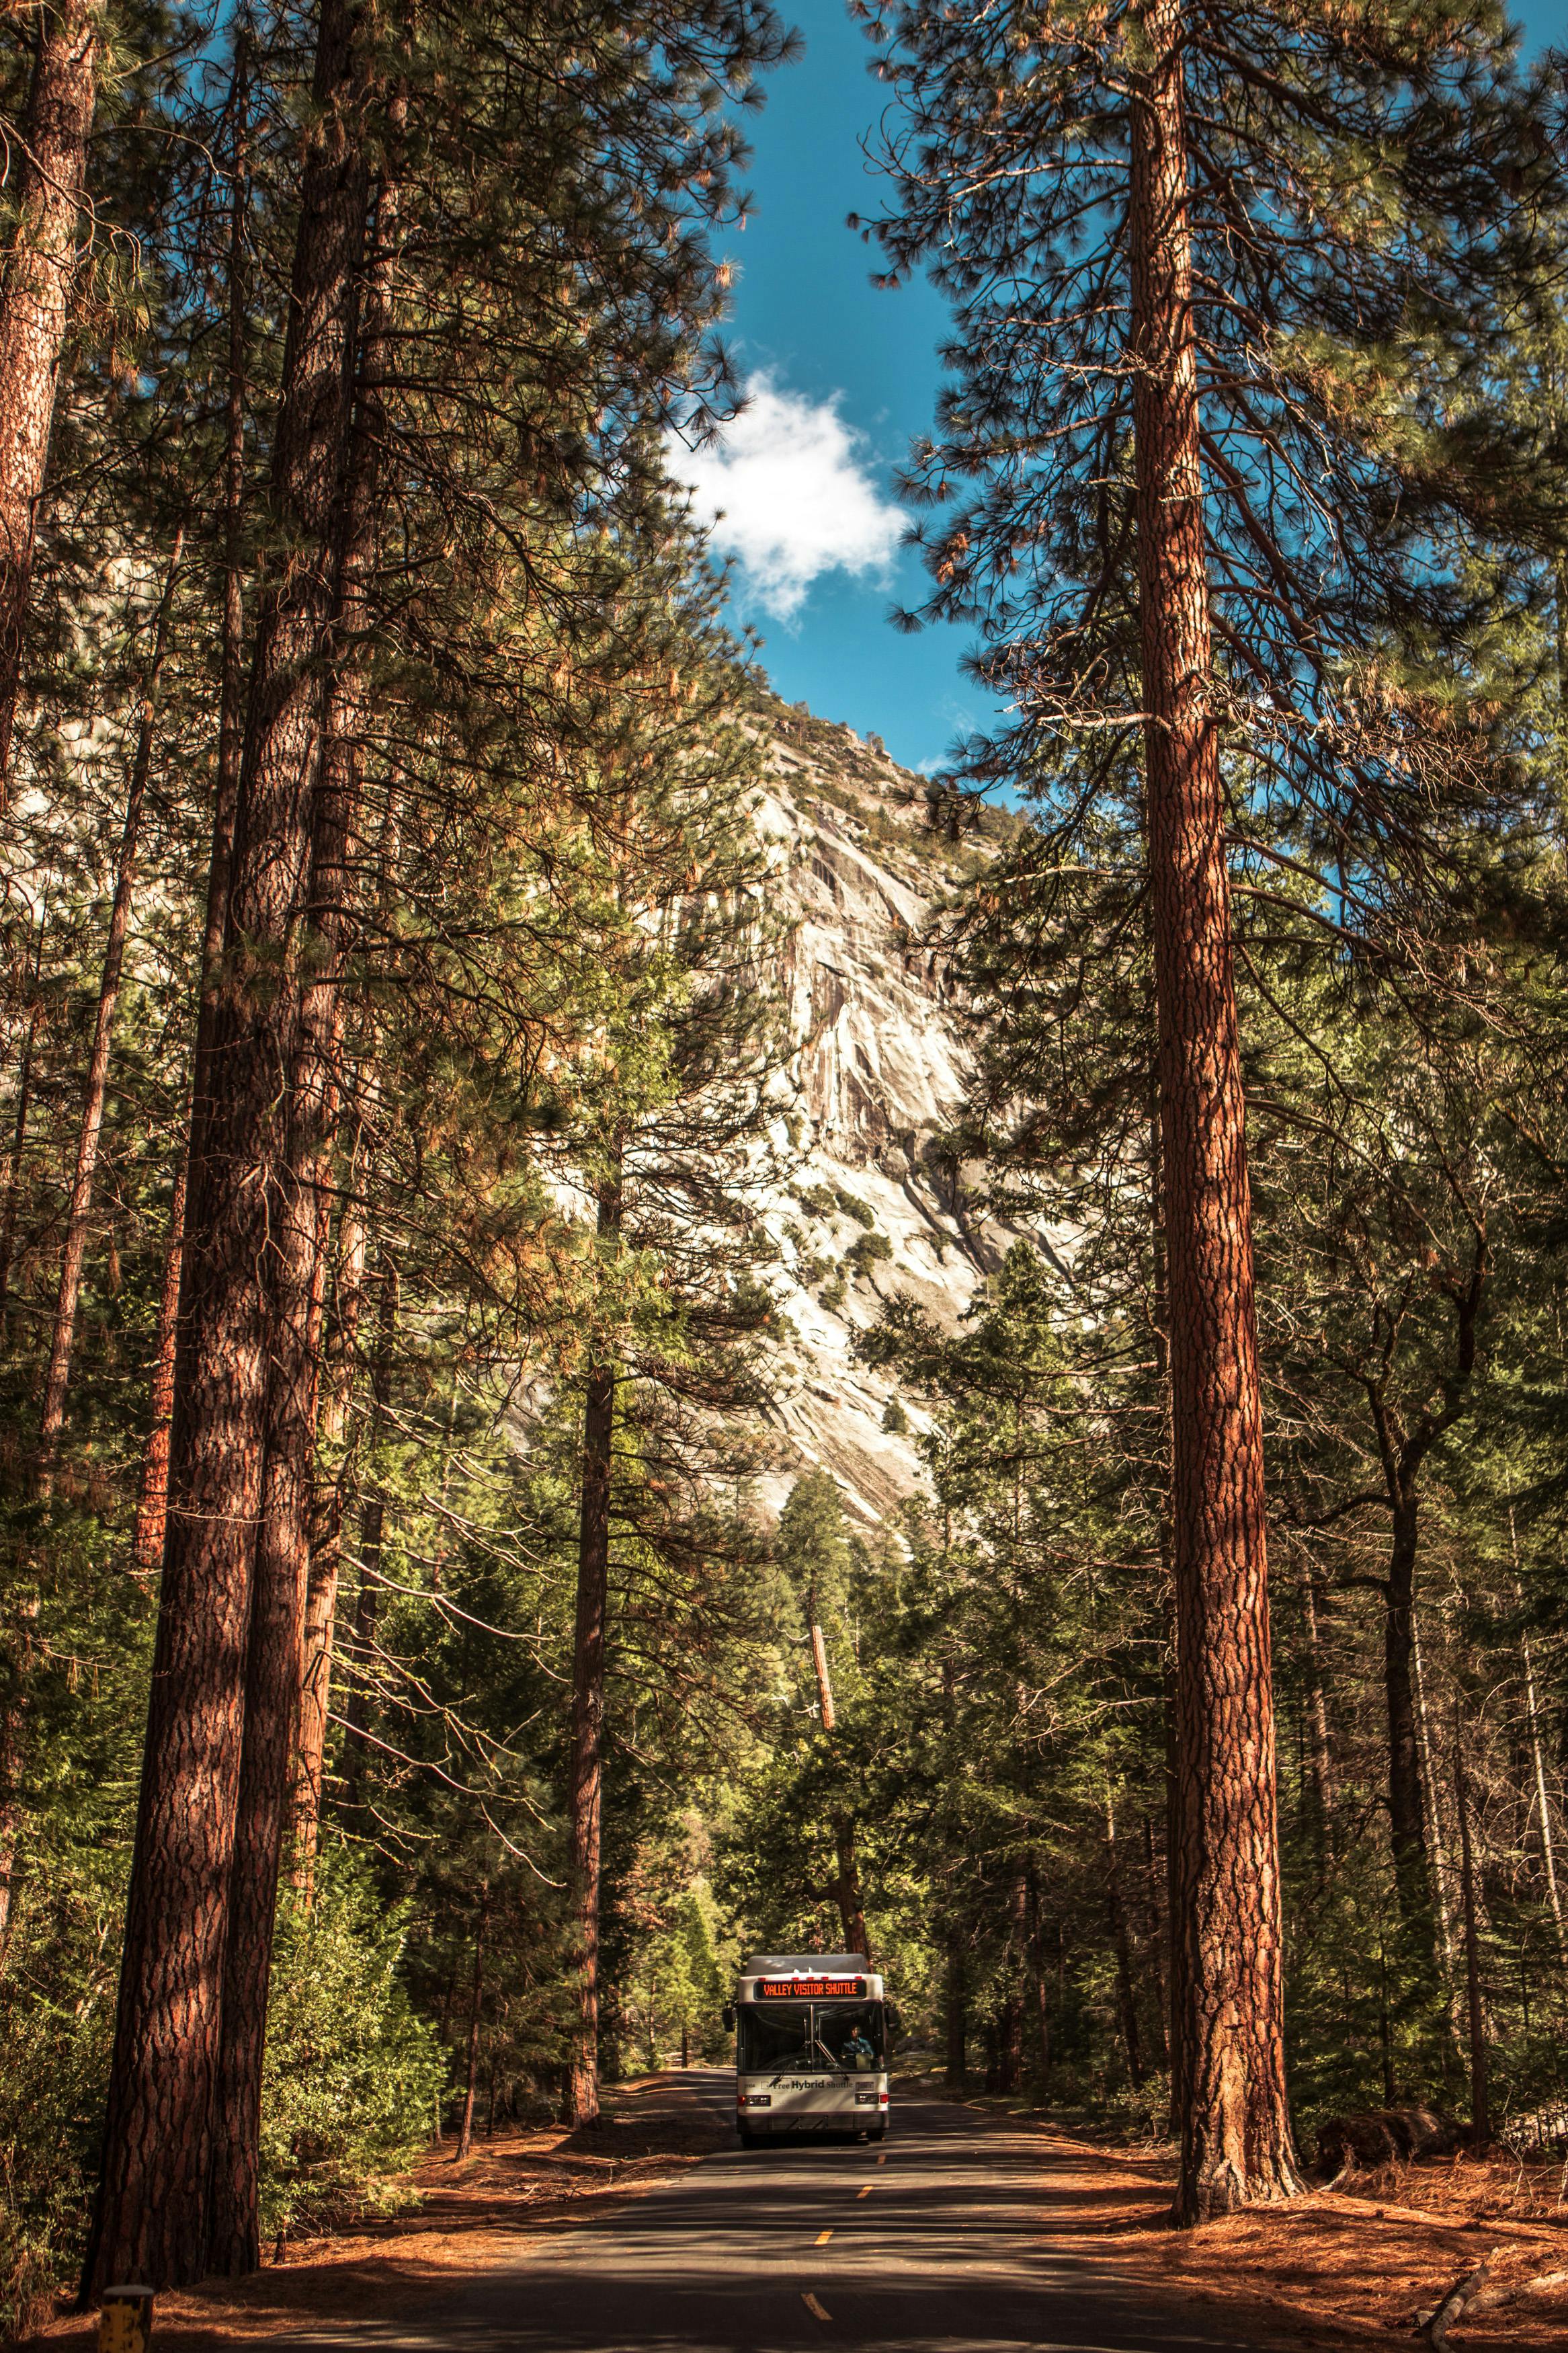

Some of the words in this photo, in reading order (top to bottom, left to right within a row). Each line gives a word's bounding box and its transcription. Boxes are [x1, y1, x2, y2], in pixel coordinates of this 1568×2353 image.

[764, 1984, 792, 1995] VALLEY
[794, 1983, 824, 1995] VISITOR
[826, 1983, 857, 1994] SHUTTLE
[792, 2080, 824, 2090] Hybrid
